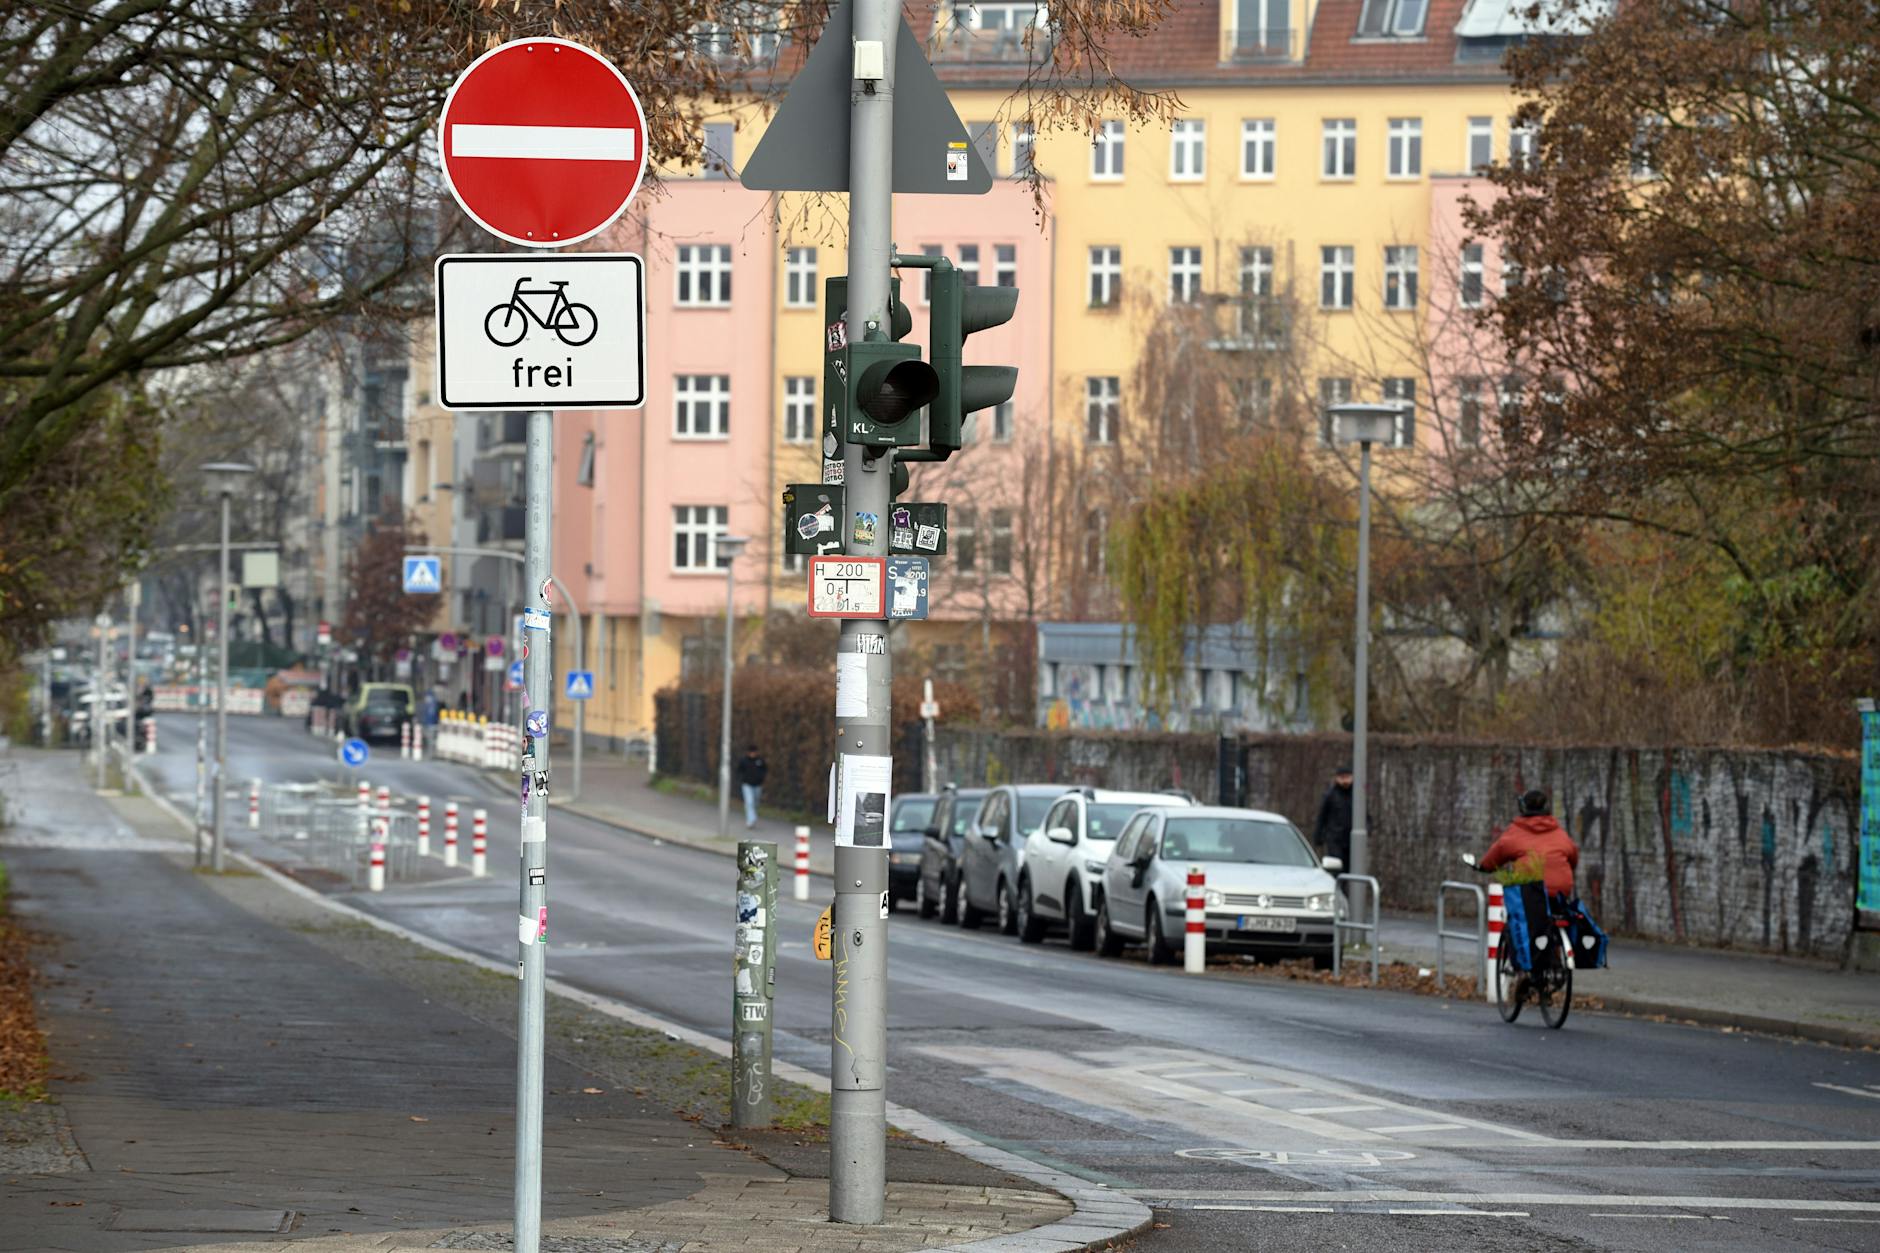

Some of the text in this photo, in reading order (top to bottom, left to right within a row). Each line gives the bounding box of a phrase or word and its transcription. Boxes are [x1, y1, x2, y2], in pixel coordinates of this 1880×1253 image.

[512, 357, 572, 387] frei
[816, 564, 863, 576] H 200
[888, 566, 898, 580] S
[744, 1006, 766, 1018] FTW
